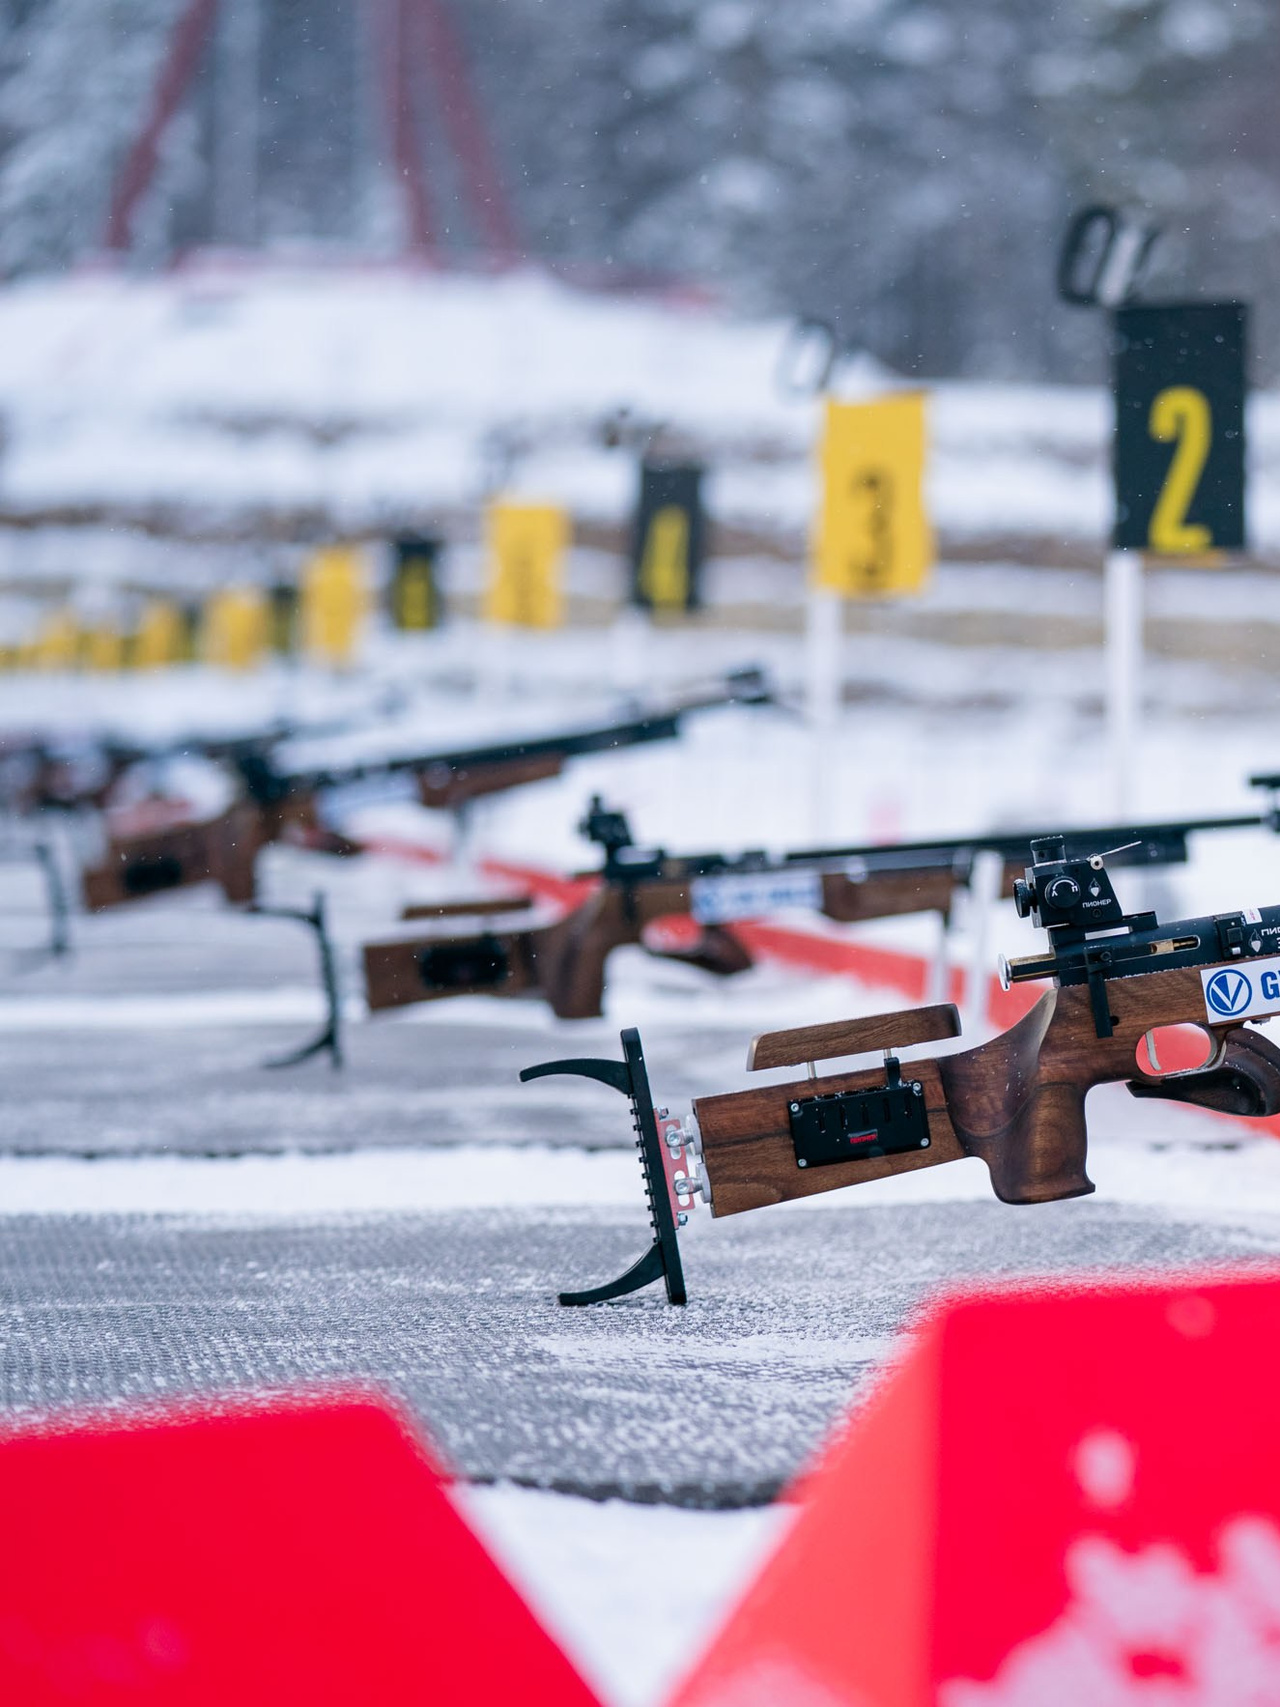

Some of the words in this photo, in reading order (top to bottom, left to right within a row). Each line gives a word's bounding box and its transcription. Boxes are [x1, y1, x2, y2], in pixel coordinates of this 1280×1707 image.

[850, 466, 895, 582] 3
[1148, 385, 1213, 553] 2
[1082, 899, 1112, 908] ПИОНЕР
